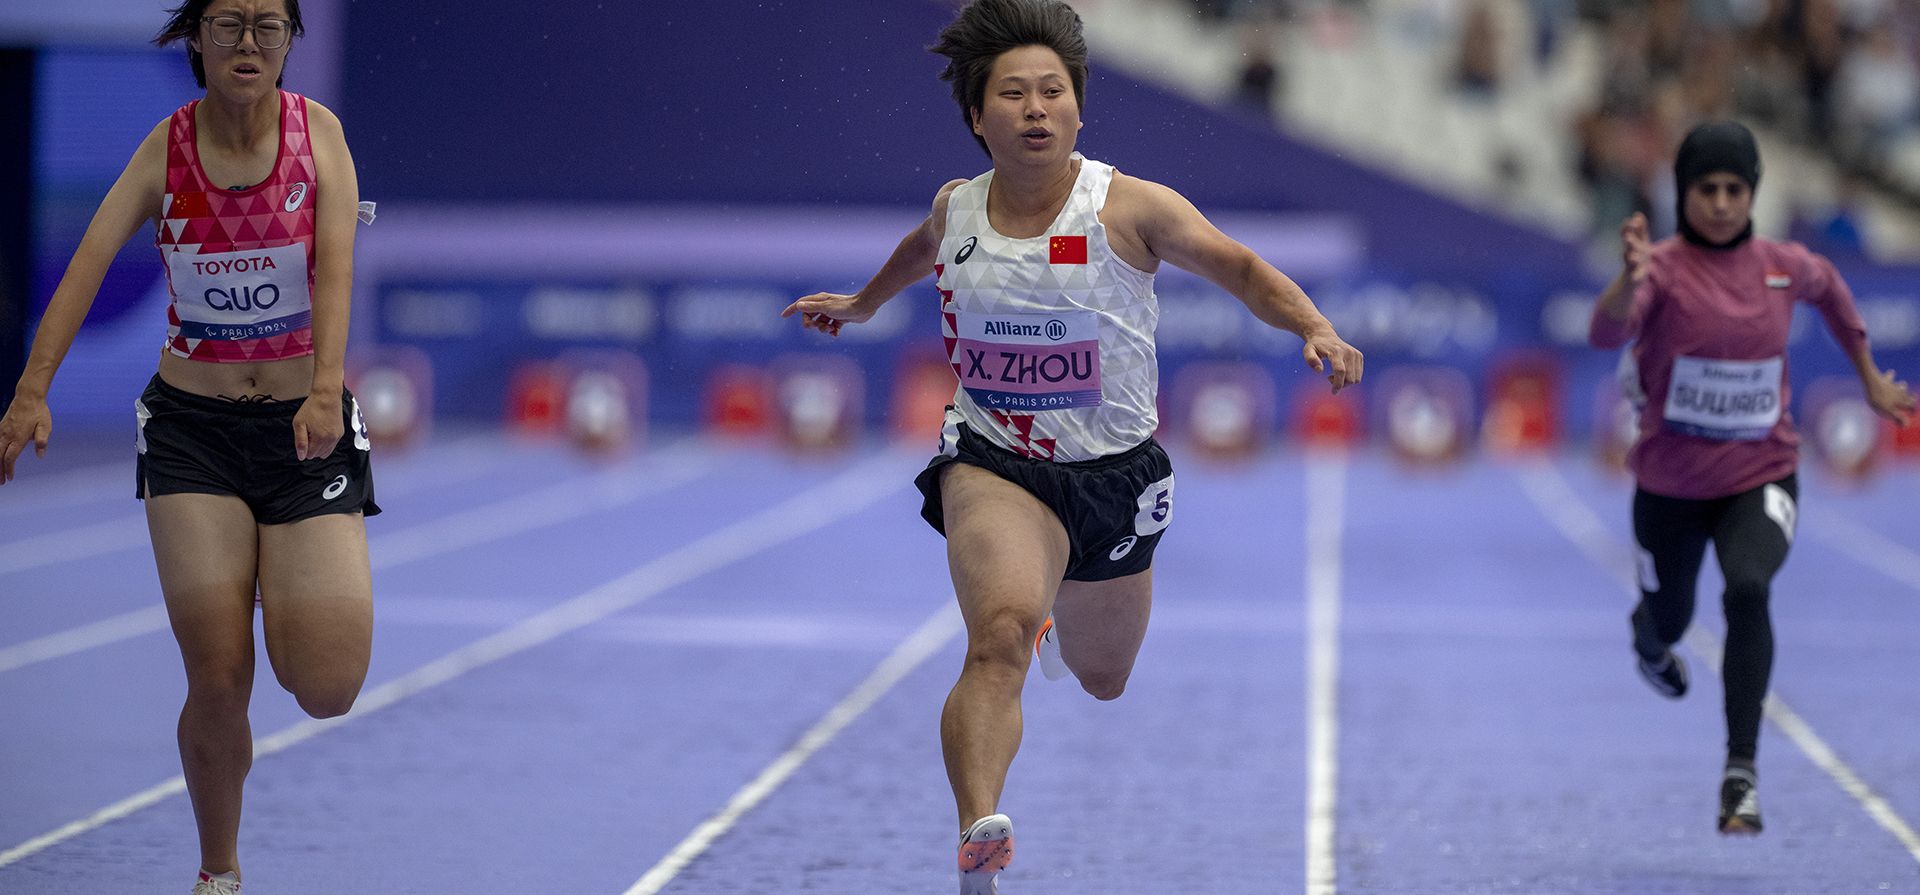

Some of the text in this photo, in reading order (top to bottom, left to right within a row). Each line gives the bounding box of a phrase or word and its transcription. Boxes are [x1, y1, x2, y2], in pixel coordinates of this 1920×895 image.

[192, 256, 276, 275] TOYOTA
[204, 283, 280, 312] GUO
[222, 322, 287, 339] PARIS 2024
[984, 321, 1042, 336] Allianz
[966, 349, 1093, 384] X. ZHOU
[1005, 396, 1073, 407] PARIS 2024
[1151, 488, 1170, 523] 5
